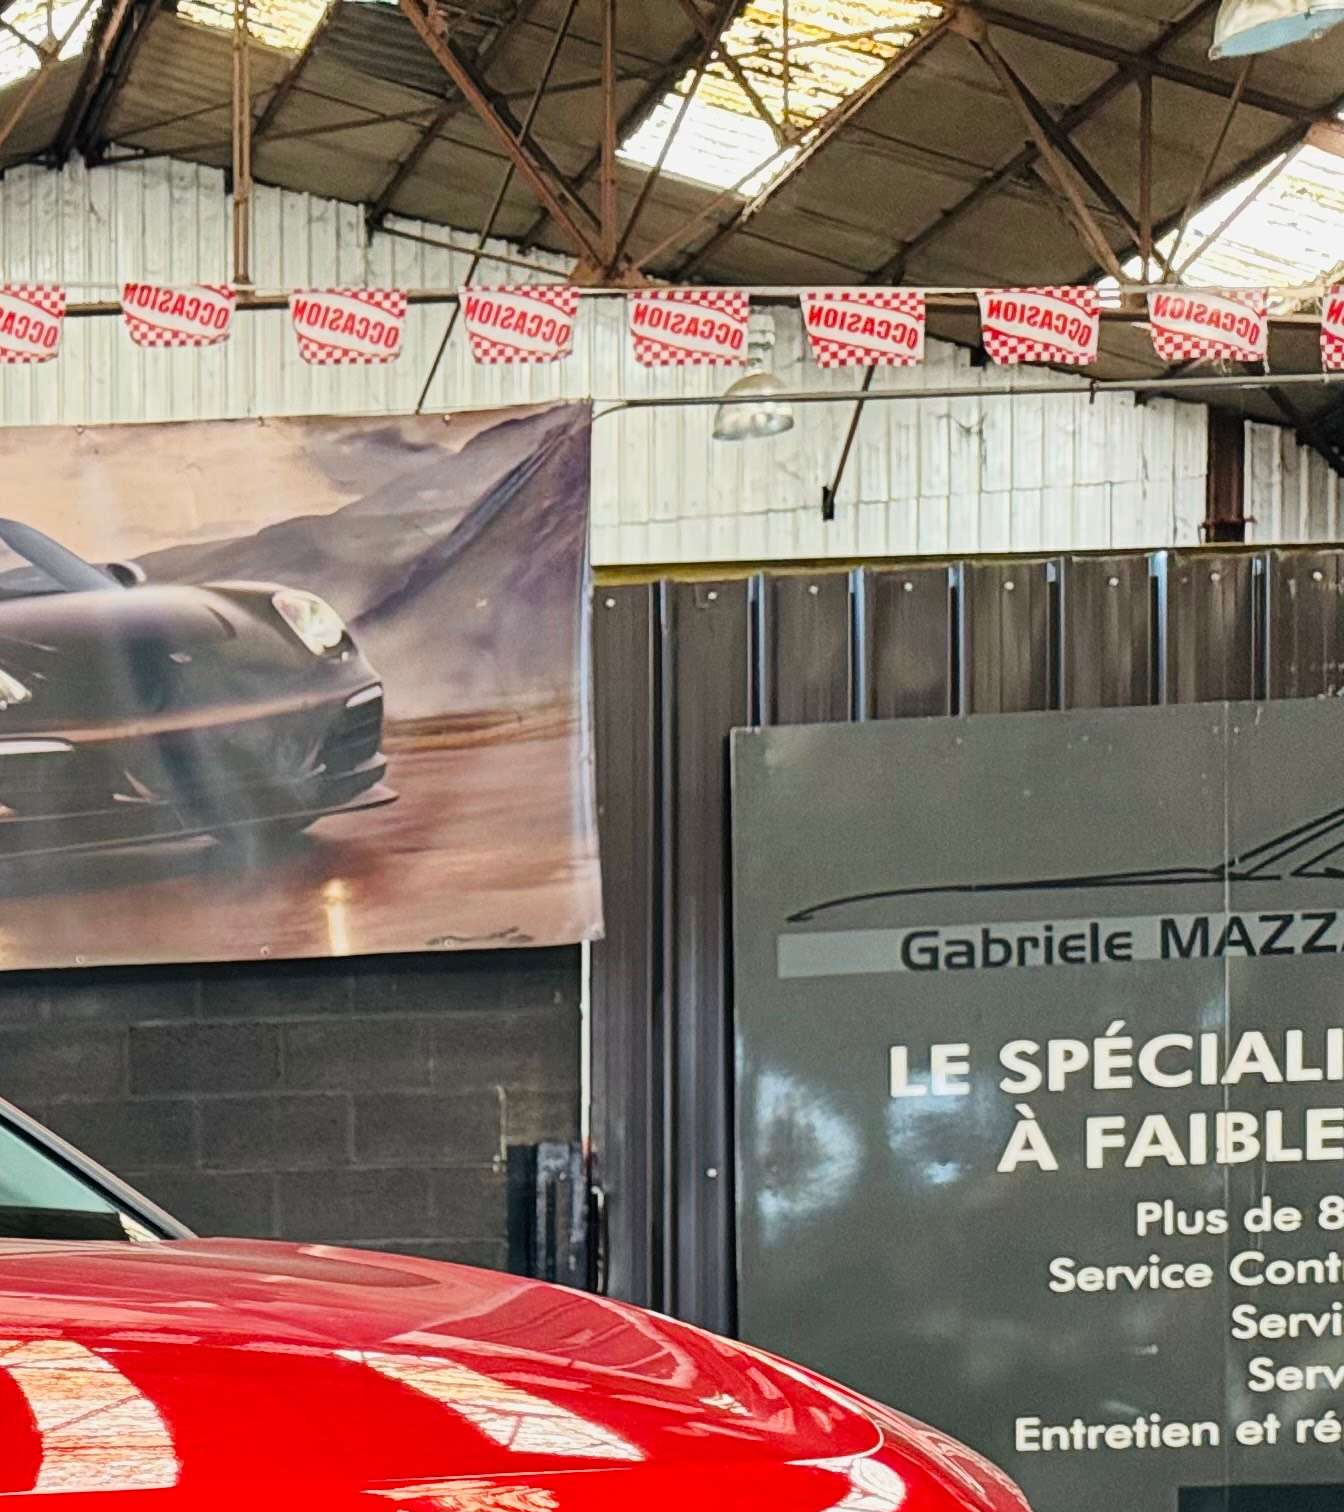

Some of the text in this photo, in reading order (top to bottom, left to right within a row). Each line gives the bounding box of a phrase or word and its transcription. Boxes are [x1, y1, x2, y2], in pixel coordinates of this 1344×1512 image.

[900, 910, 1344, 972] Gabriele MAZZ
[889, 1019, 1344, 1099] LE SPÉCIALI
[996, 1102, 1344, 1174] À FAIBLE
[1135, 1194, 1344, 1238] Plus de 8
[1048, 1250, 1344, 1293] Service Cont
[1230, 1301, 1344, 1341] Servi
[1247, 1356, 1344, 1393] Serv
[1014, 1409, 1343, 1453] Entretien et ré
